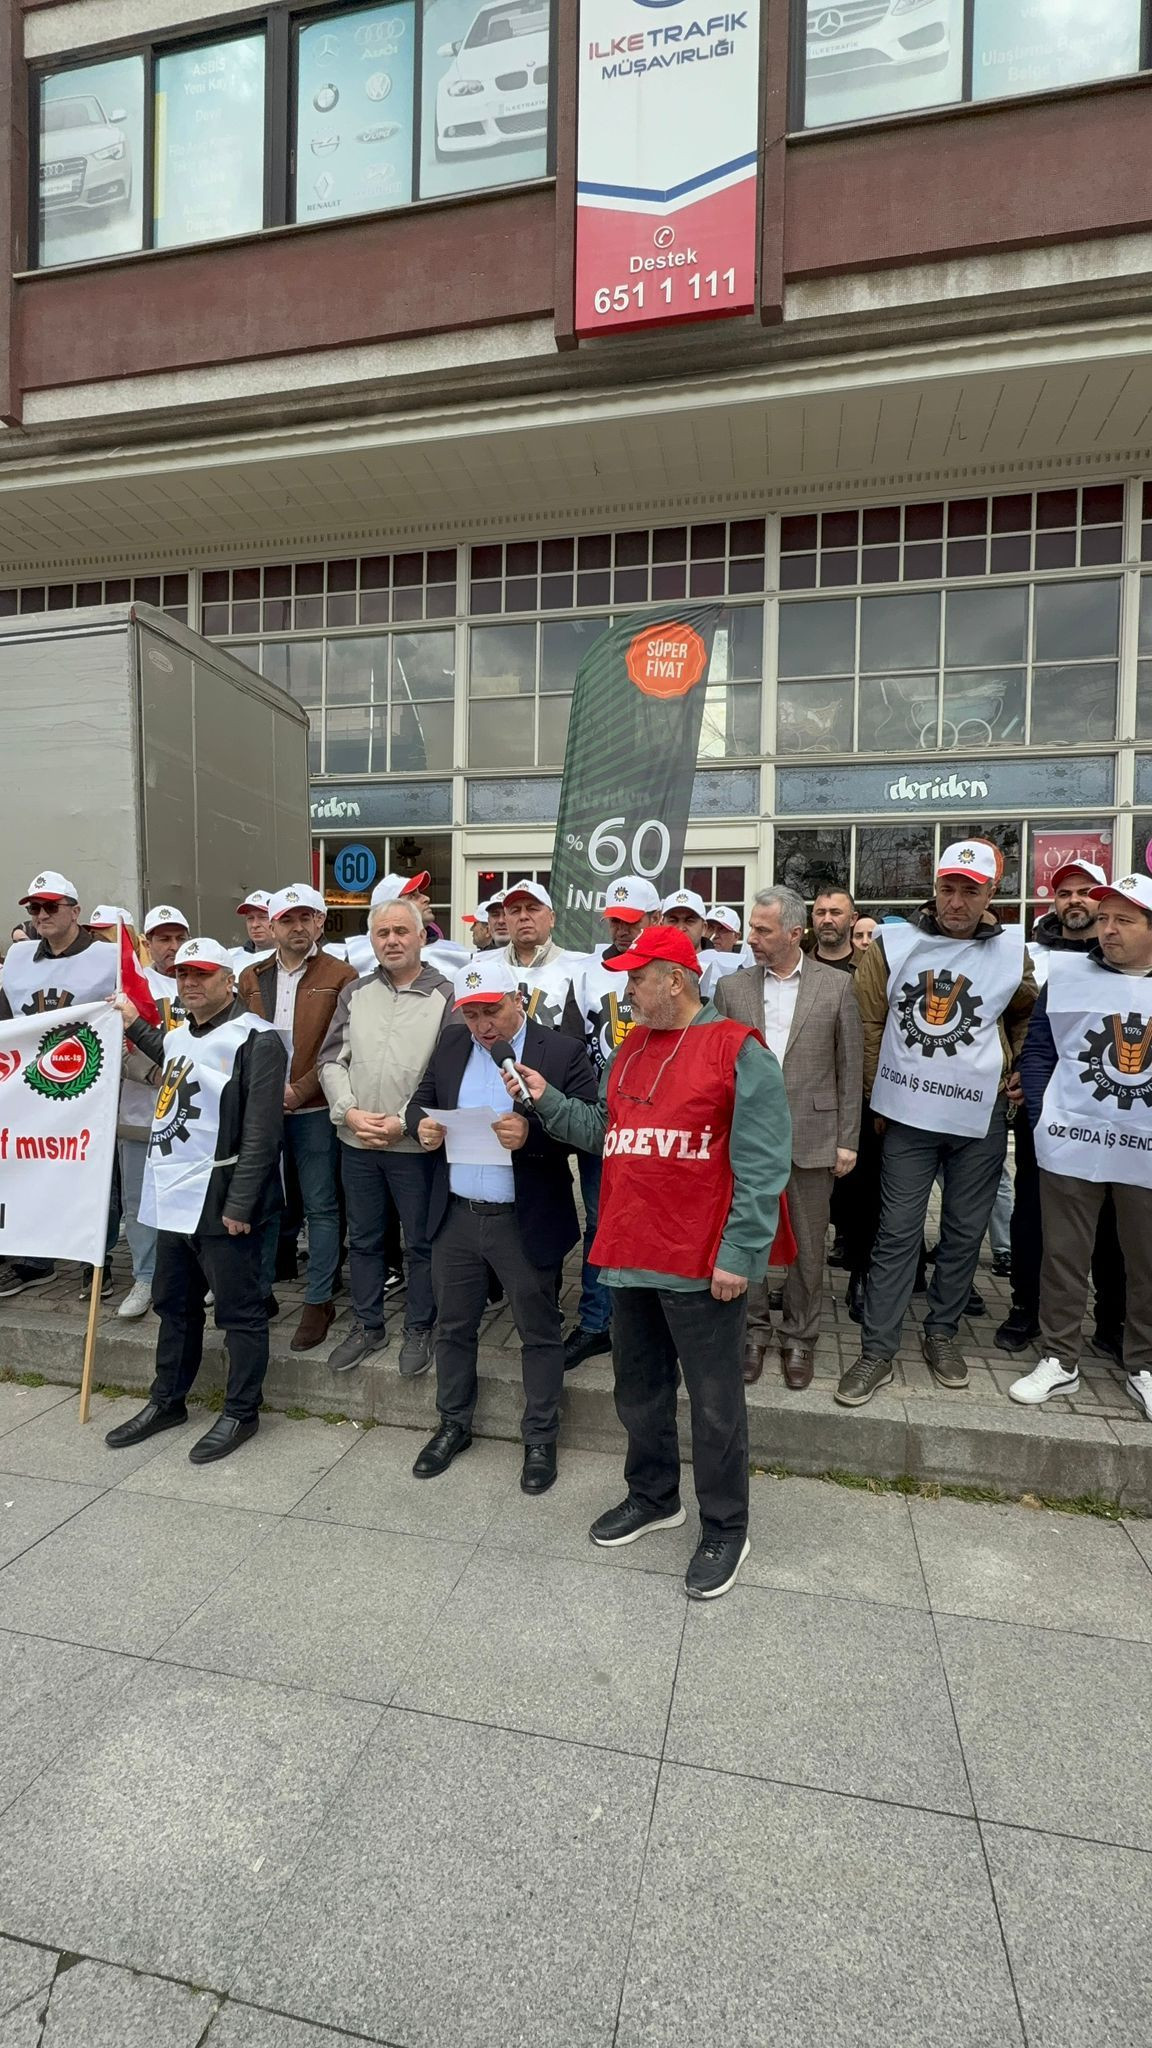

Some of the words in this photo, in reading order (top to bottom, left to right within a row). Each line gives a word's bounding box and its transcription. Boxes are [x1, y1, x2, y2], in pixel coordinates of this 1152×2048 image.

[307, 199, 342, 212] RENAULT
[629, 248, 698, 274] Destek
[594, 281, 645, 314] 651
[660, 276, 672, 304] 1
[688, 267, 736, 300] 111
[646, 638, 688, 659] SÜPER
[645, 658, 685, 679] FİYAT
[889, 773, 989, 801] deriden
[310, 796, 361, 818] riden
[342, 852, 369, 883] 60
[935, 982, 951, 991] 1976
[171, 1005, 186, 1015] 1976
[619, 1005, 632, 1014] 197
[906, 1021, 921, 1042] GIDA
[923, 1035, 931, 1046] İŞ
[933, 1017, 972, 1047] SENDİKASI
[1123, 1026, 1142, 1036] 1976
[52, 1054, 82, 1064] HAK-İŞ
[595, 1053, 607, 1070] GID
[1090, 1056, 1100, 1070] ÖZ
[881, 1063, 890, 1078] ÖZ
[890, 1069, 907, 1087] GIDA
[909, 1073, 920, 1093] İŞ
[922, 1079, 984, 1103] SENDİKASI
[1094, 1072, 1114, 1093] GIDA
[1117, 1085, 1127, 1097] İŞ
[16, 1128, 91, 1161] mısın?
[1048, 1122, 1066, 1139] ÖZ
[1069, 1127, 1101, 1144] GIDA
[1104, 1129, 1116, 1149] İŞ
[1119, 1133, 1152, 1151] SEND
